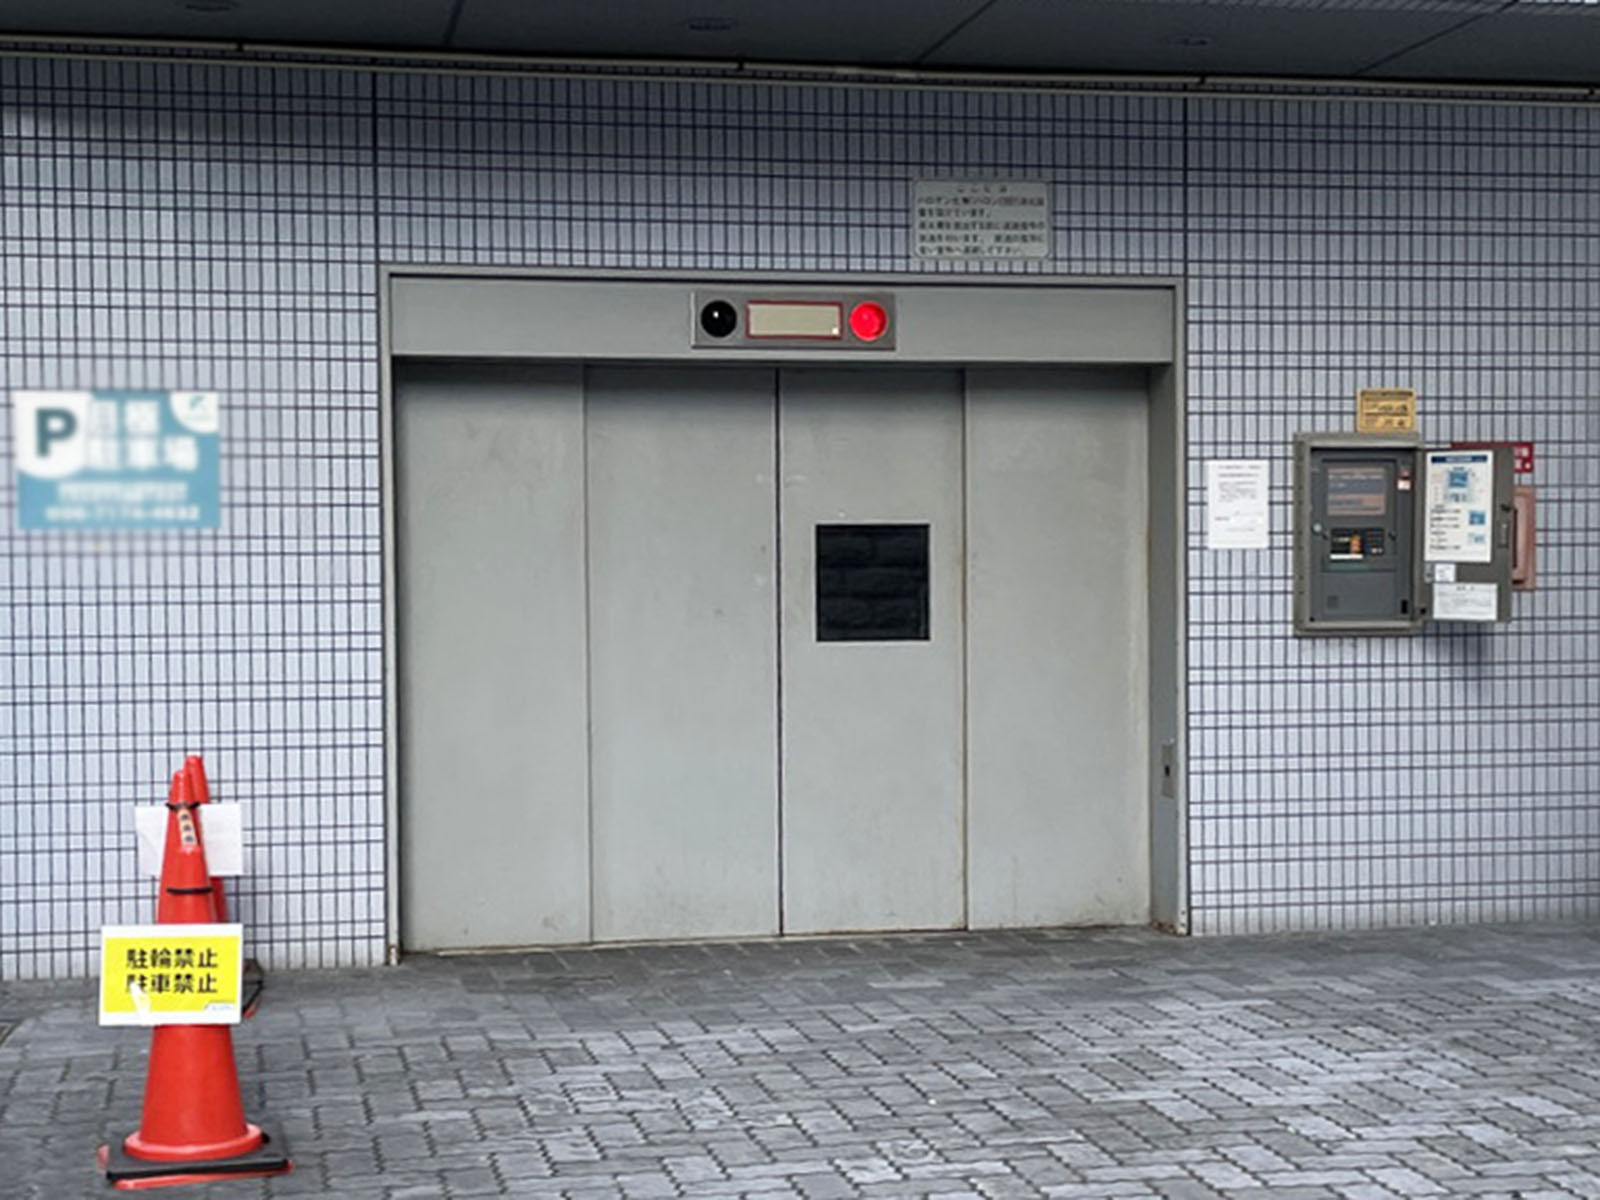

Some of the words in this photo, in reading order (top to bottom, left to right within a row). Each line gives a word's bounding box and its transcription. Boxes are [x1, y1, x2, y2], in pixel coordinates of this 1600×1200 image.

[35, 407, 77, 458] P
[126, 948, 218, 969] 駐輪禁止
